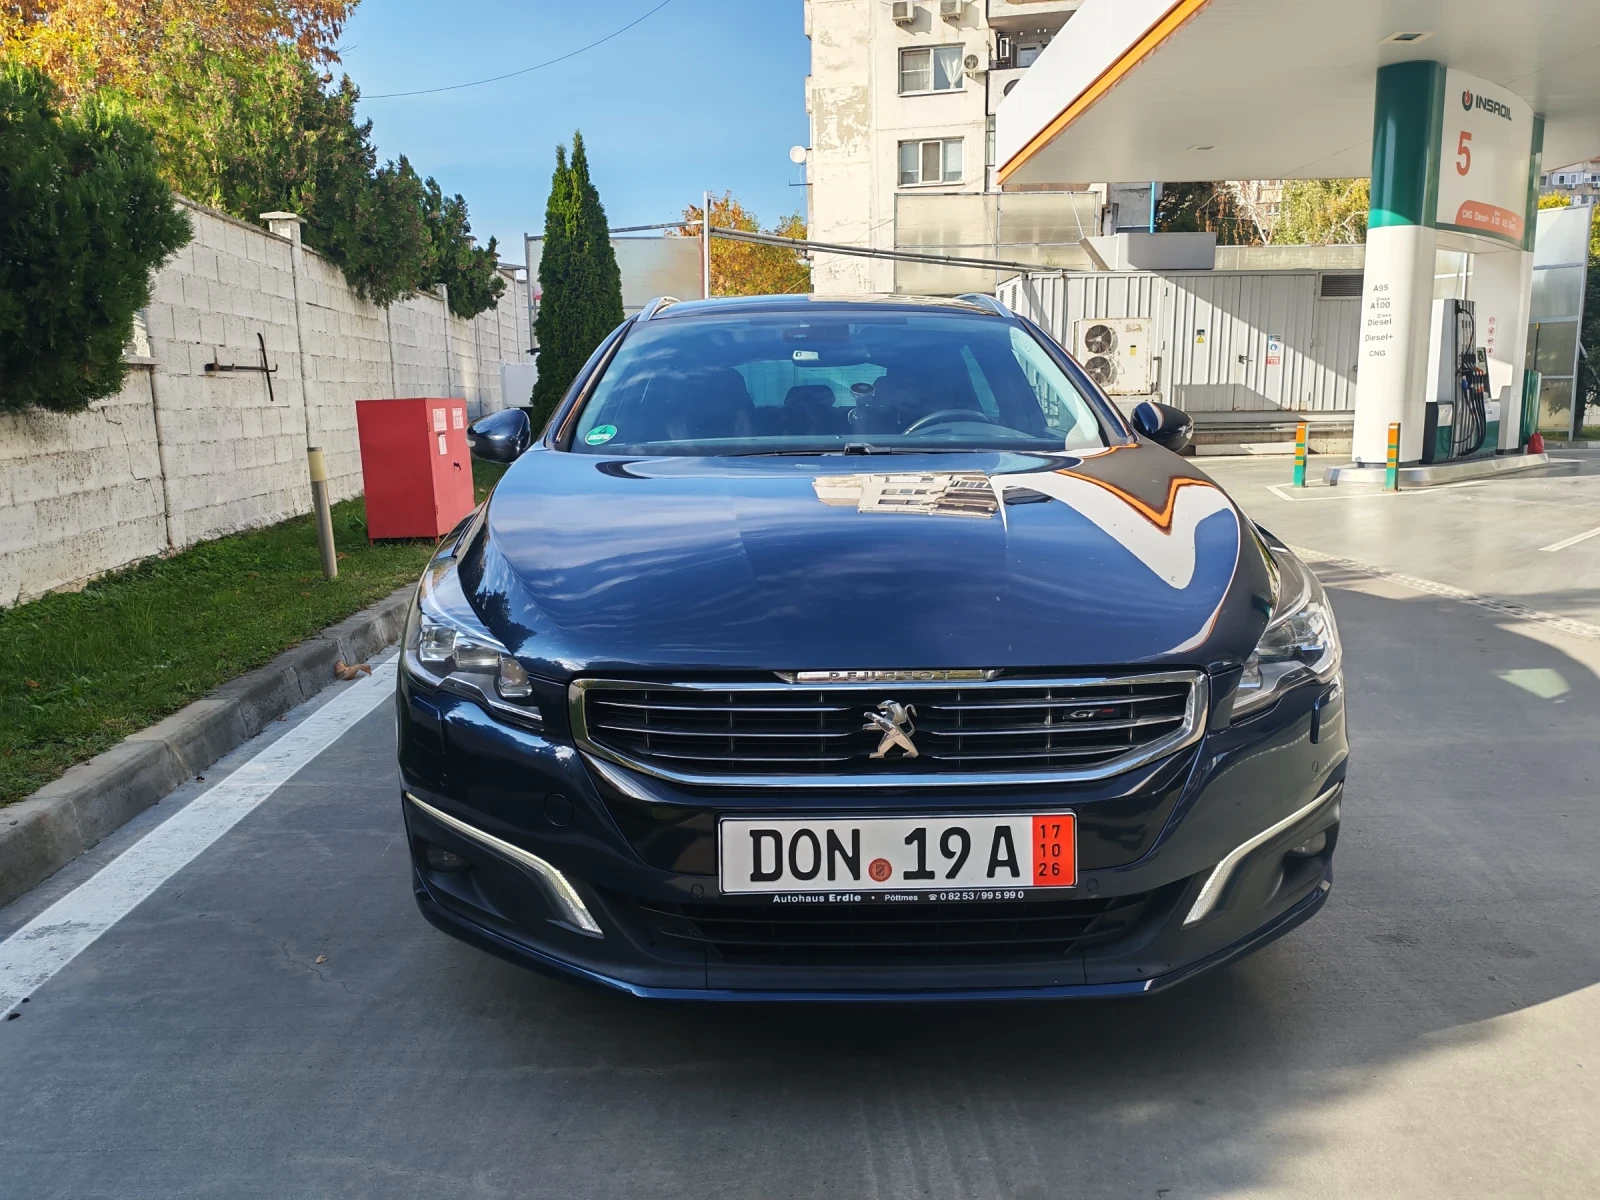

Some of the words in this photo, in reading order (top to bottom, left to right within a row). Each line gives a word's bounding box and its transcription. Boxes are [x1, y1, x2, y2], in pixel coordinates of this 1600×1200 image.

[1475, 95, 1512, 121] INSAOIL
[1455, 130, 1473, 177] 5
[1373, 284, 1389, 292] A95
[1367, 318, 1392, 326] Diesel
[1040, 824, 1060, 839] 17
[749, 828, 861, 882] DON
[903, 826, 971, 880] 19
[986, 825, 1021, 878] A
[1040, 843, 1060, 857] 10
[1039, 862, 1060, 877] 26
[773, 894, 825, 903] Autohaus
[829, 893, 862, 903] Erdle
